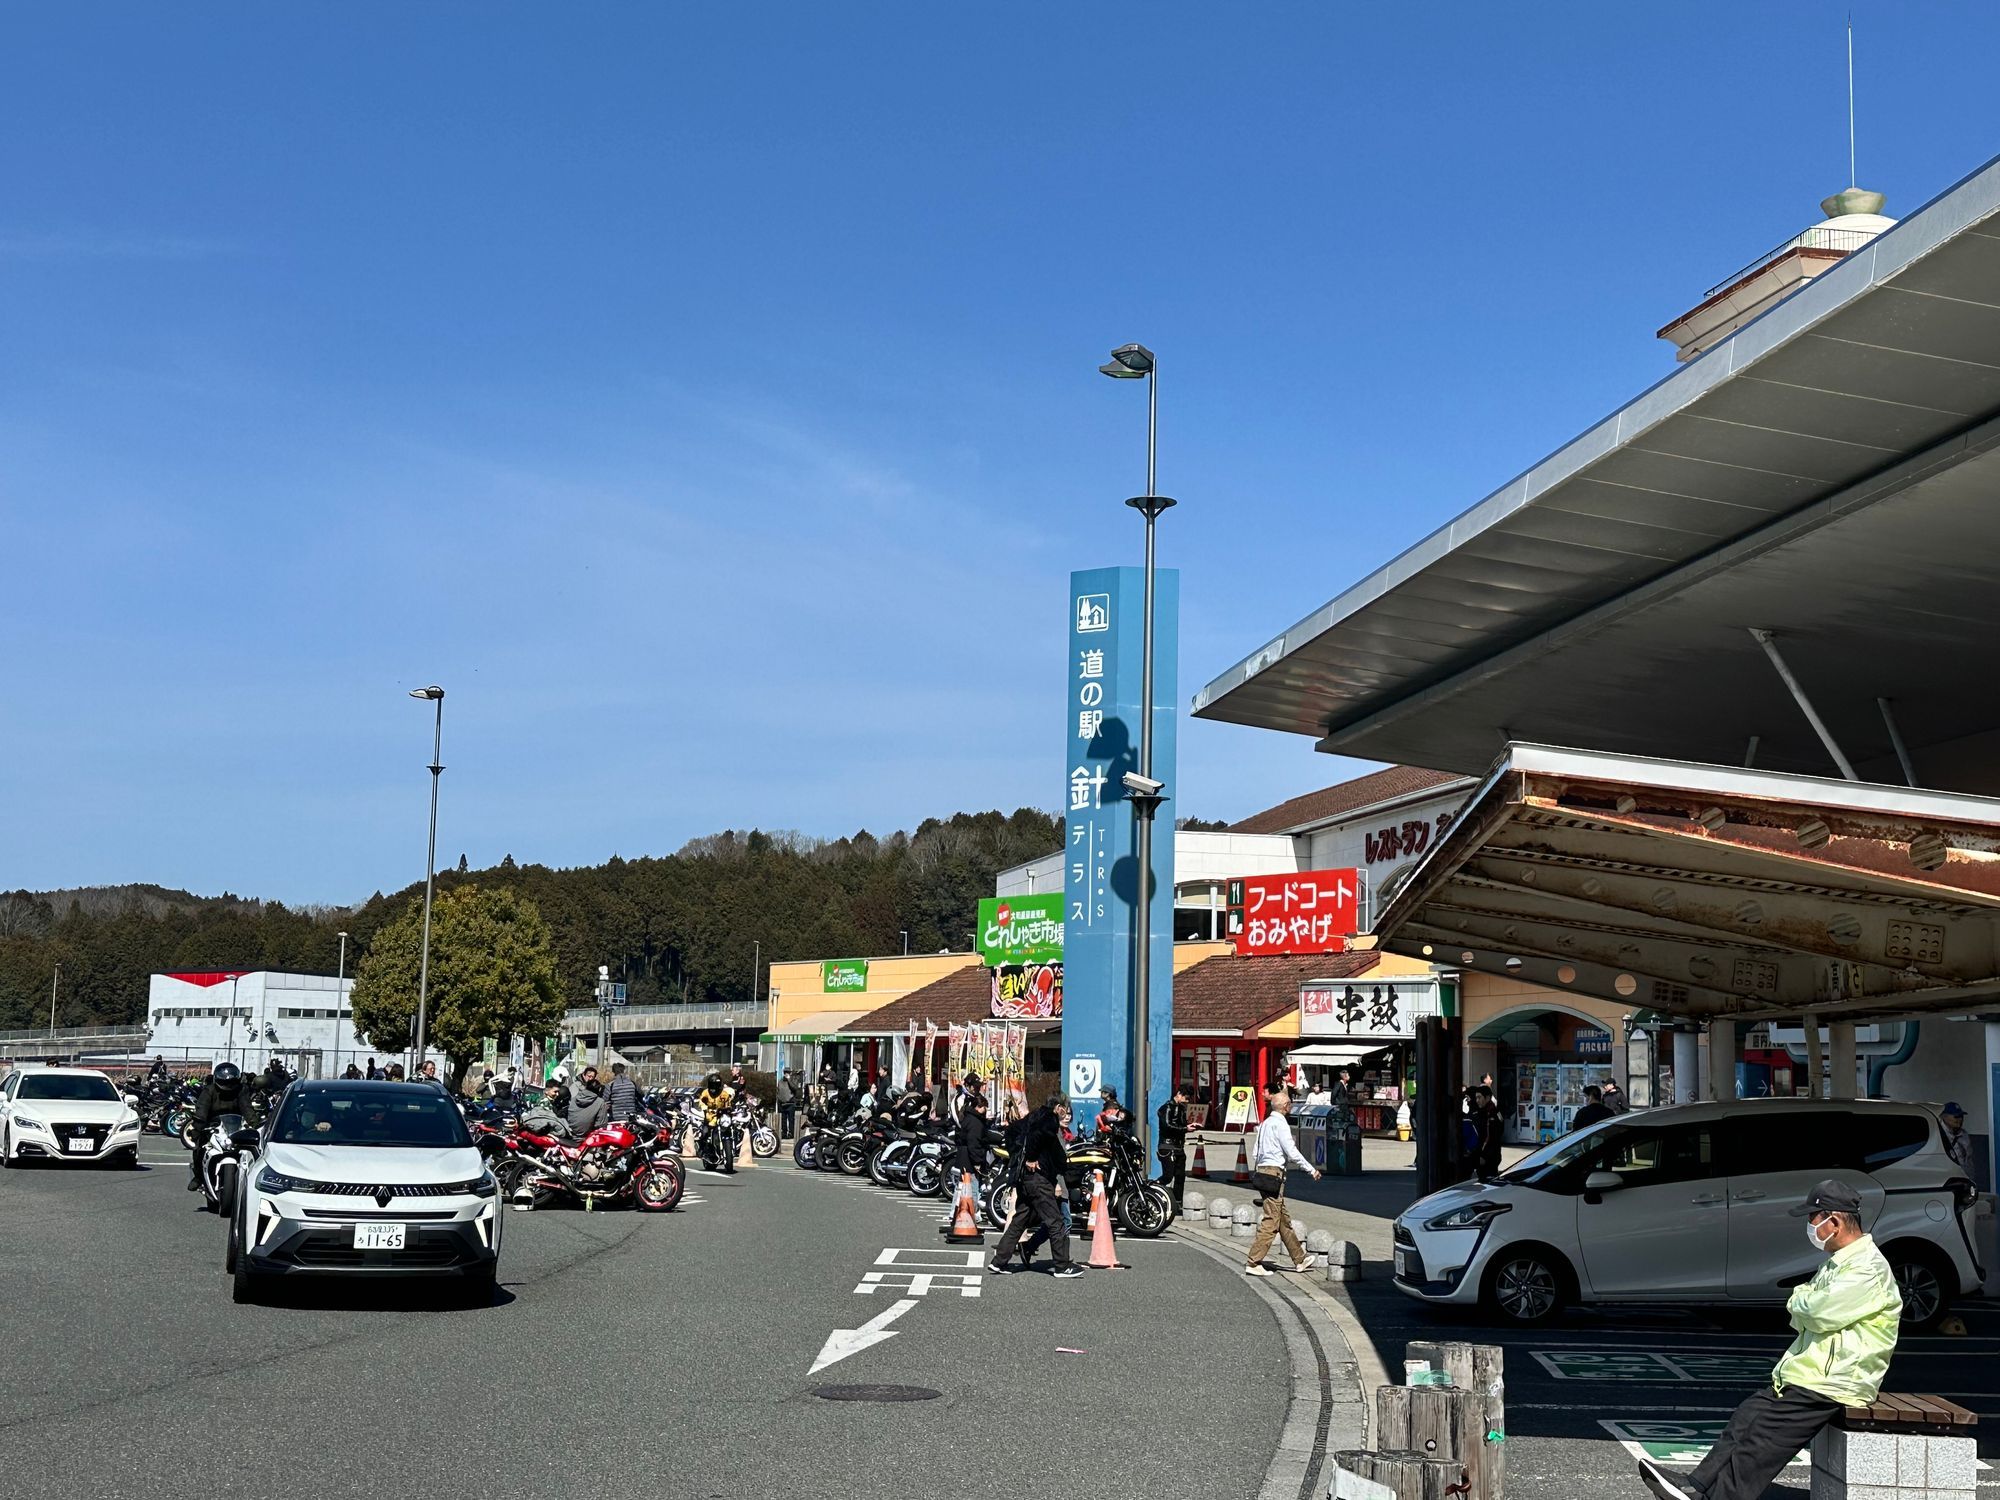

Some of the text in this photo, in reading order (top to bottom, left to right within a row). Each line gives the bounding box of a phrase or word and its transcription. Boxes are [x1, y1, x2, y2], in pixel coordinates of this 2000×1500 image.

[1078, 649, 1104, 739] 道の駅
[1070, 764, 1108, 811] 針
[1365, 821, 1430, 864] レストラン
[1072, 825, 1086, 920] テラス
[1248, 878, 1353, 914] フードコート
[1248, 913, 1333, 947] おみやげ
[1305, 991, 1332, 1012] 名代
[367, 1234, 402, 1247] 11-65
